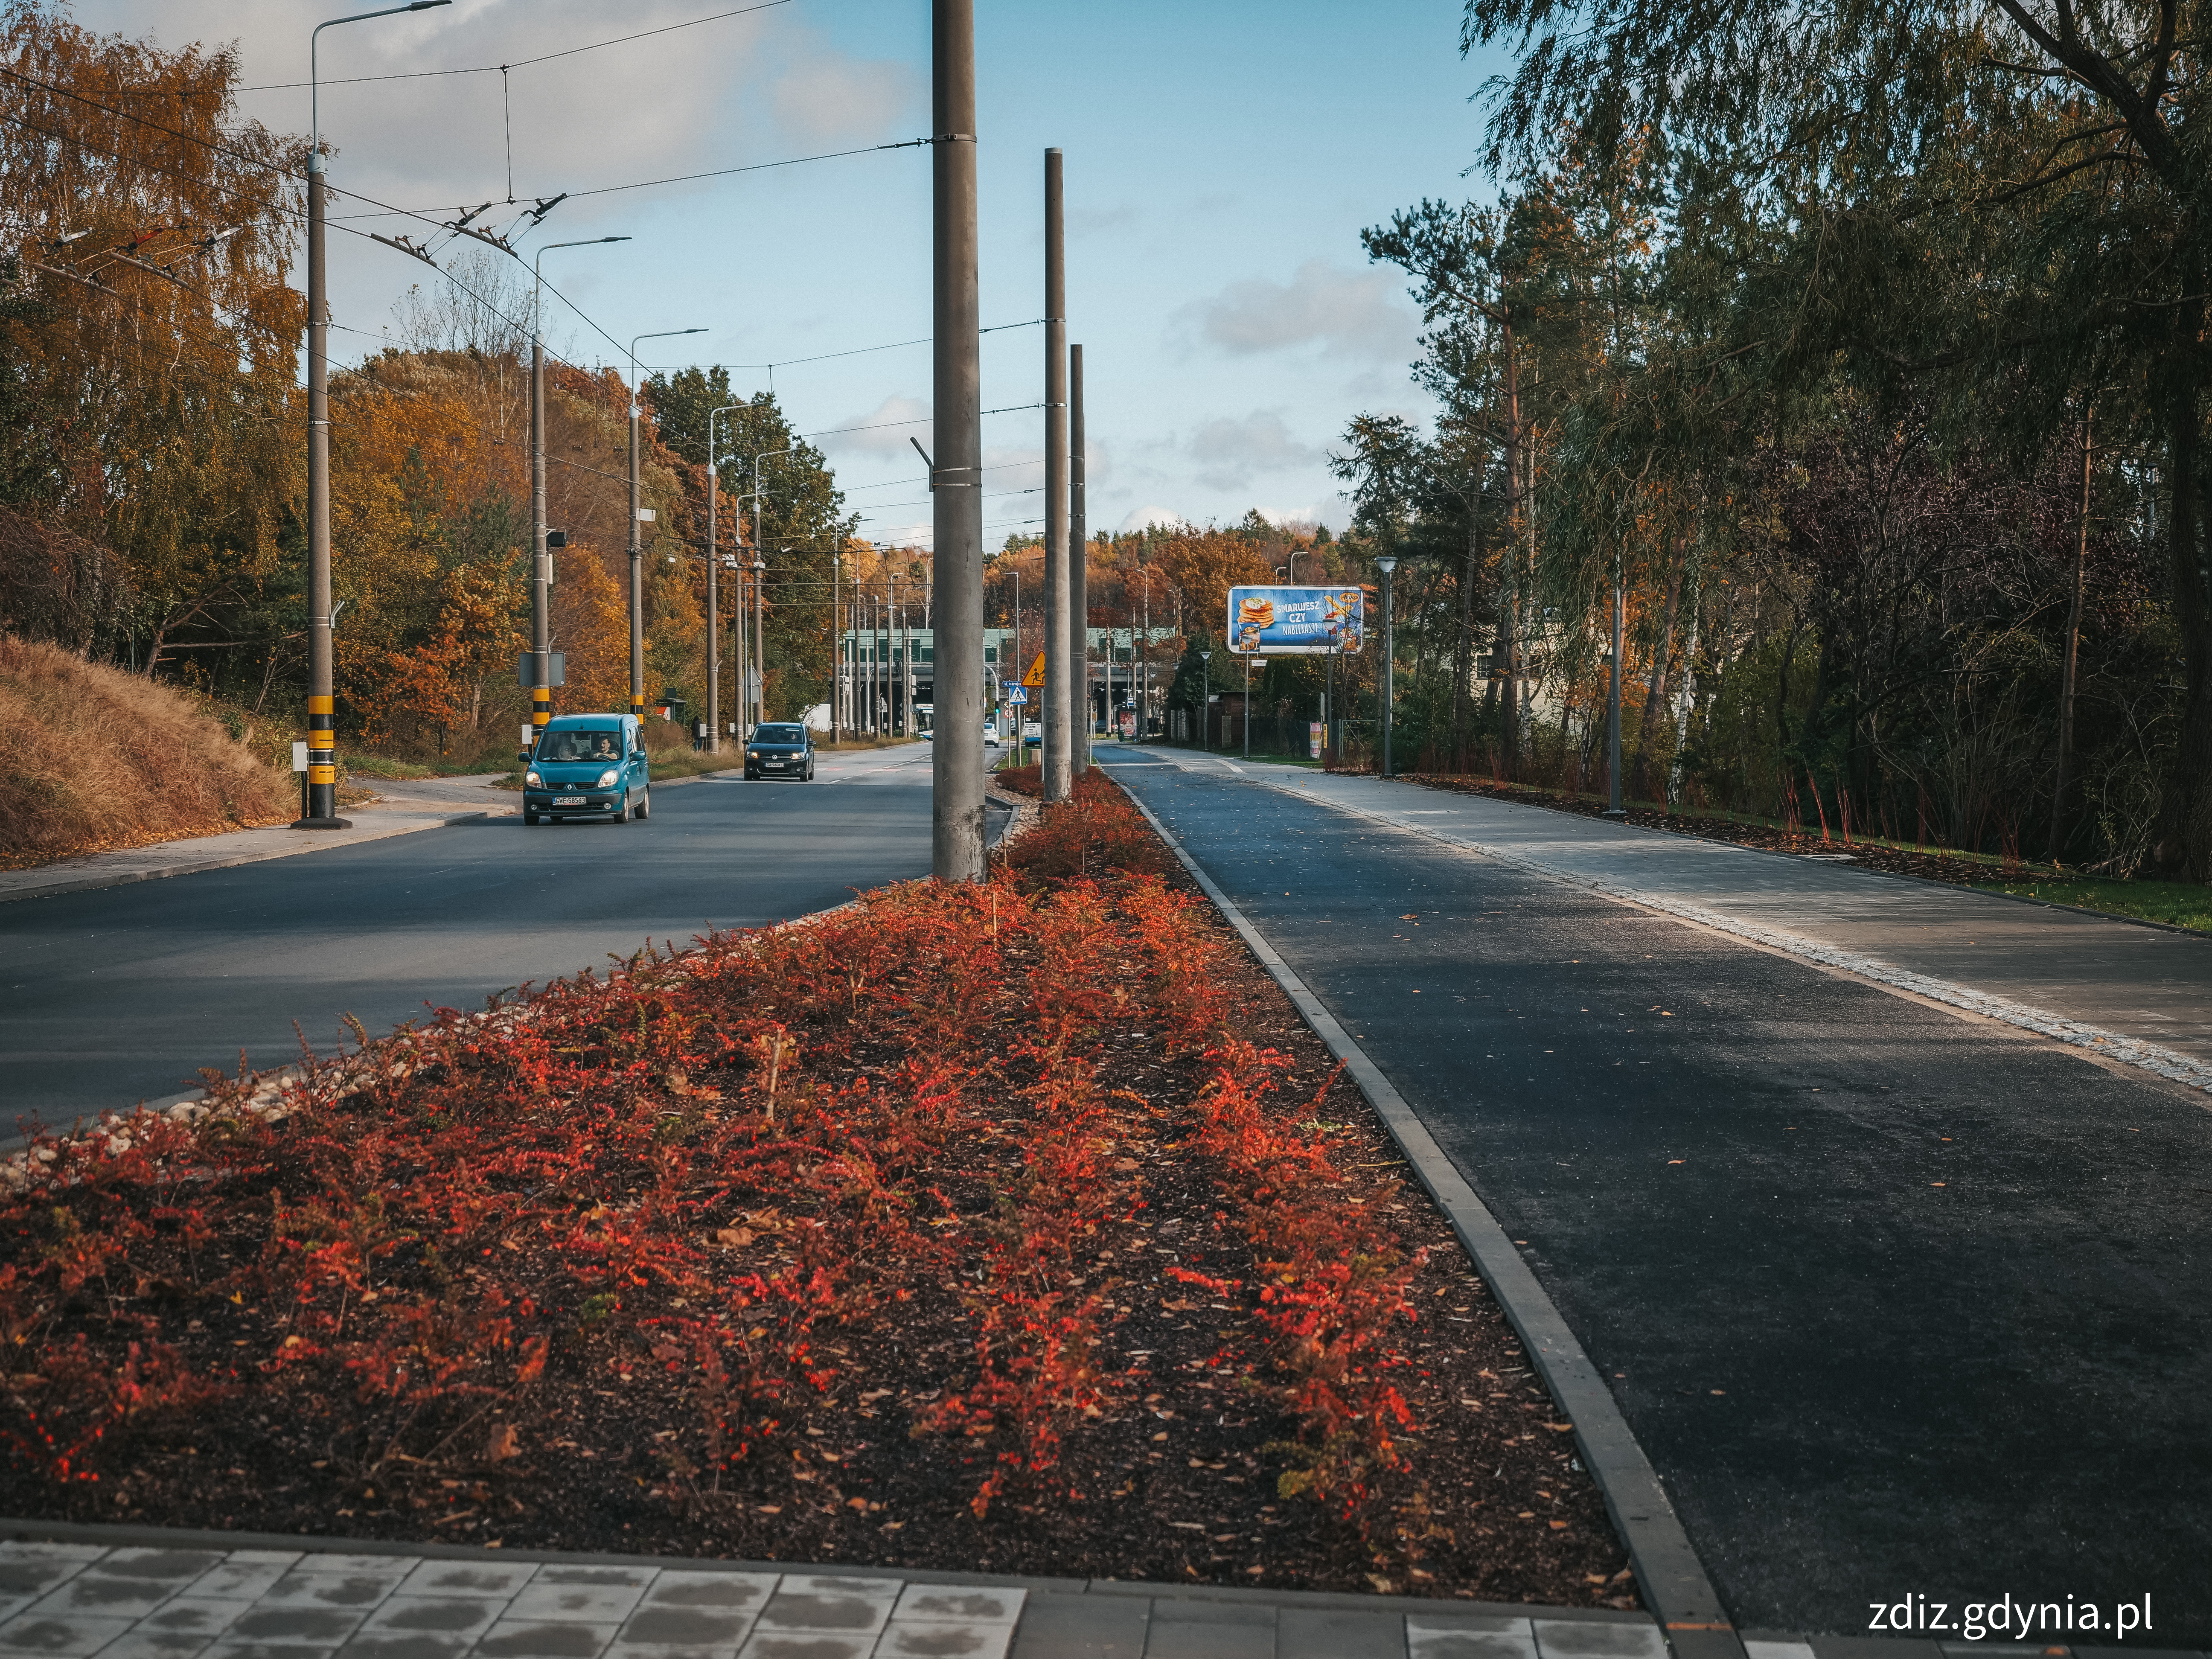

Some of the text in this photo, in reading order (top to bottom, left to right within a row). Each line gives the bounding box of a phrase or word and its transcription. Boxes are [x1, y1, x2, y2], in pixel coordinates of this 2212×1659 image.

[1276, 601, 1319, 613] SMARUJESZ
[1289, 612, 1306, 623] CZY
[1283, 622, 1318, 636] NABIERASZ?
